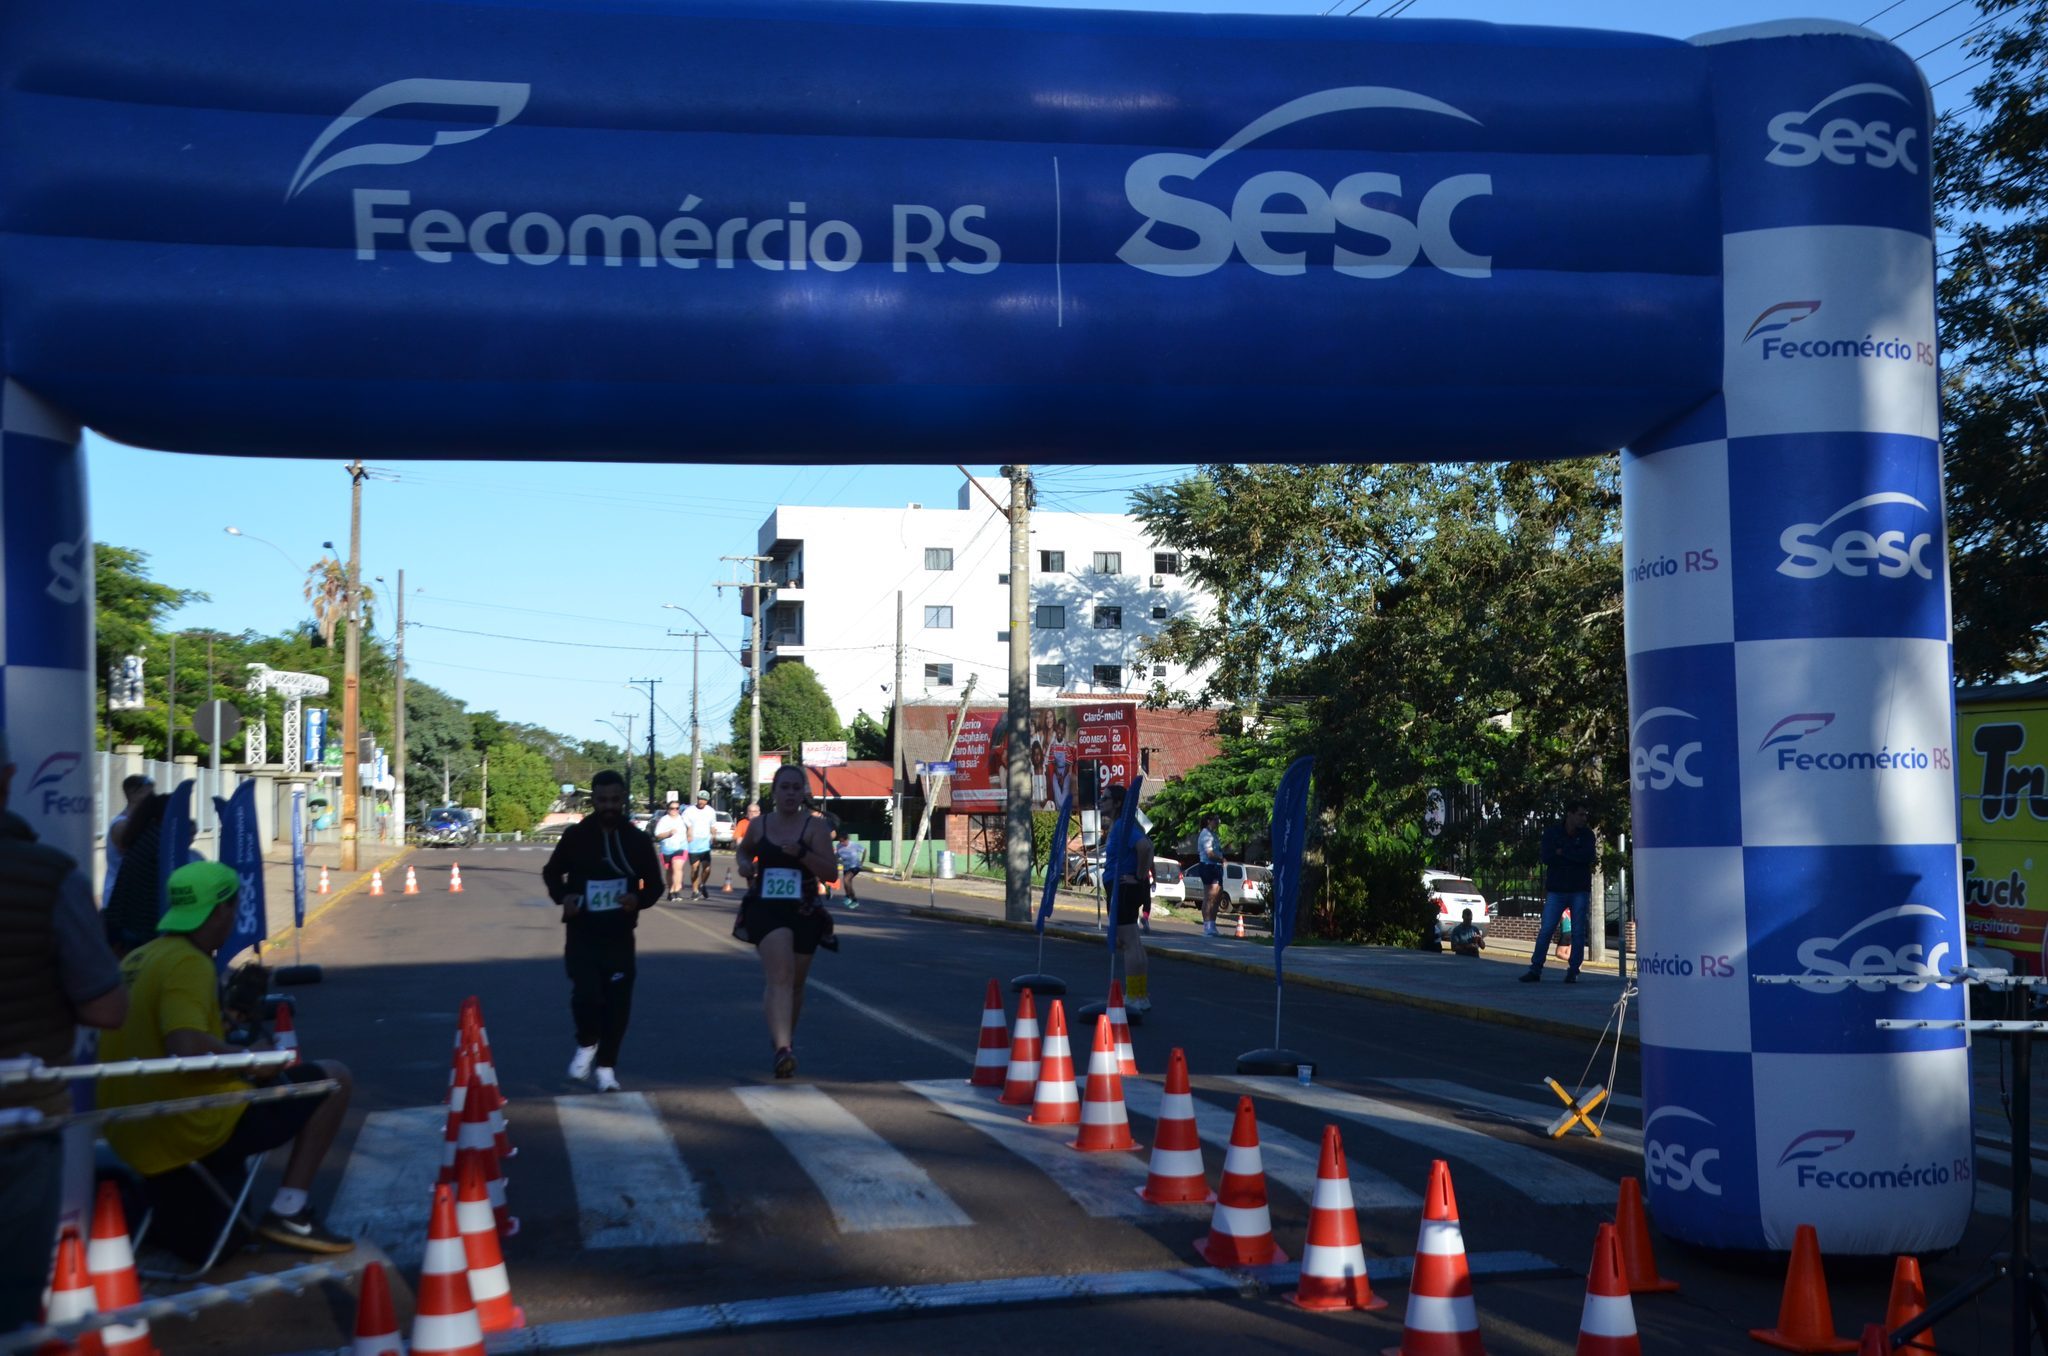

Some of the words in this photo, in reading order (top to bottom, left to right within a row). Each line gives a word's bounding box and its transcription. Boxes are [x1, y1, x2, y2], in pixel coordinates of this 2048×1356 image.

[1764, 83, 1918, 175] Sesc
[1115, 86, 1494, 280] Sesc
[352, 187, 863, 275] Fecomércio
[891, 203, 1002, 275] RS
[1762, 334, 1911, 361] Fecomércio
[1916, 341, 1934, 367] RS
[1776, 491, 1932, 580] Sesc
[1685, 548, 1719, 573] RS
[957, 731, 991, 744] estphalen,
[1091, 735, 1107, 743] MEGA
[1630, 742, 1704, 791] esc
[1778, 747, 1928, 771] Fecomércio
[1933, 748, 1951, 770] RS
[1099, 764, 1125, 788] 9,90
[767, 878, 796, 895] 326
[1638, 951, 1694, 977] mércio
[1700, 955, 1735, 978] RS
[1646, 1139, 1722, 1196] esc
[1797, 1162, 1949, 1188] Fecomércio
[1953, 1158, 1970, 1182] RS
